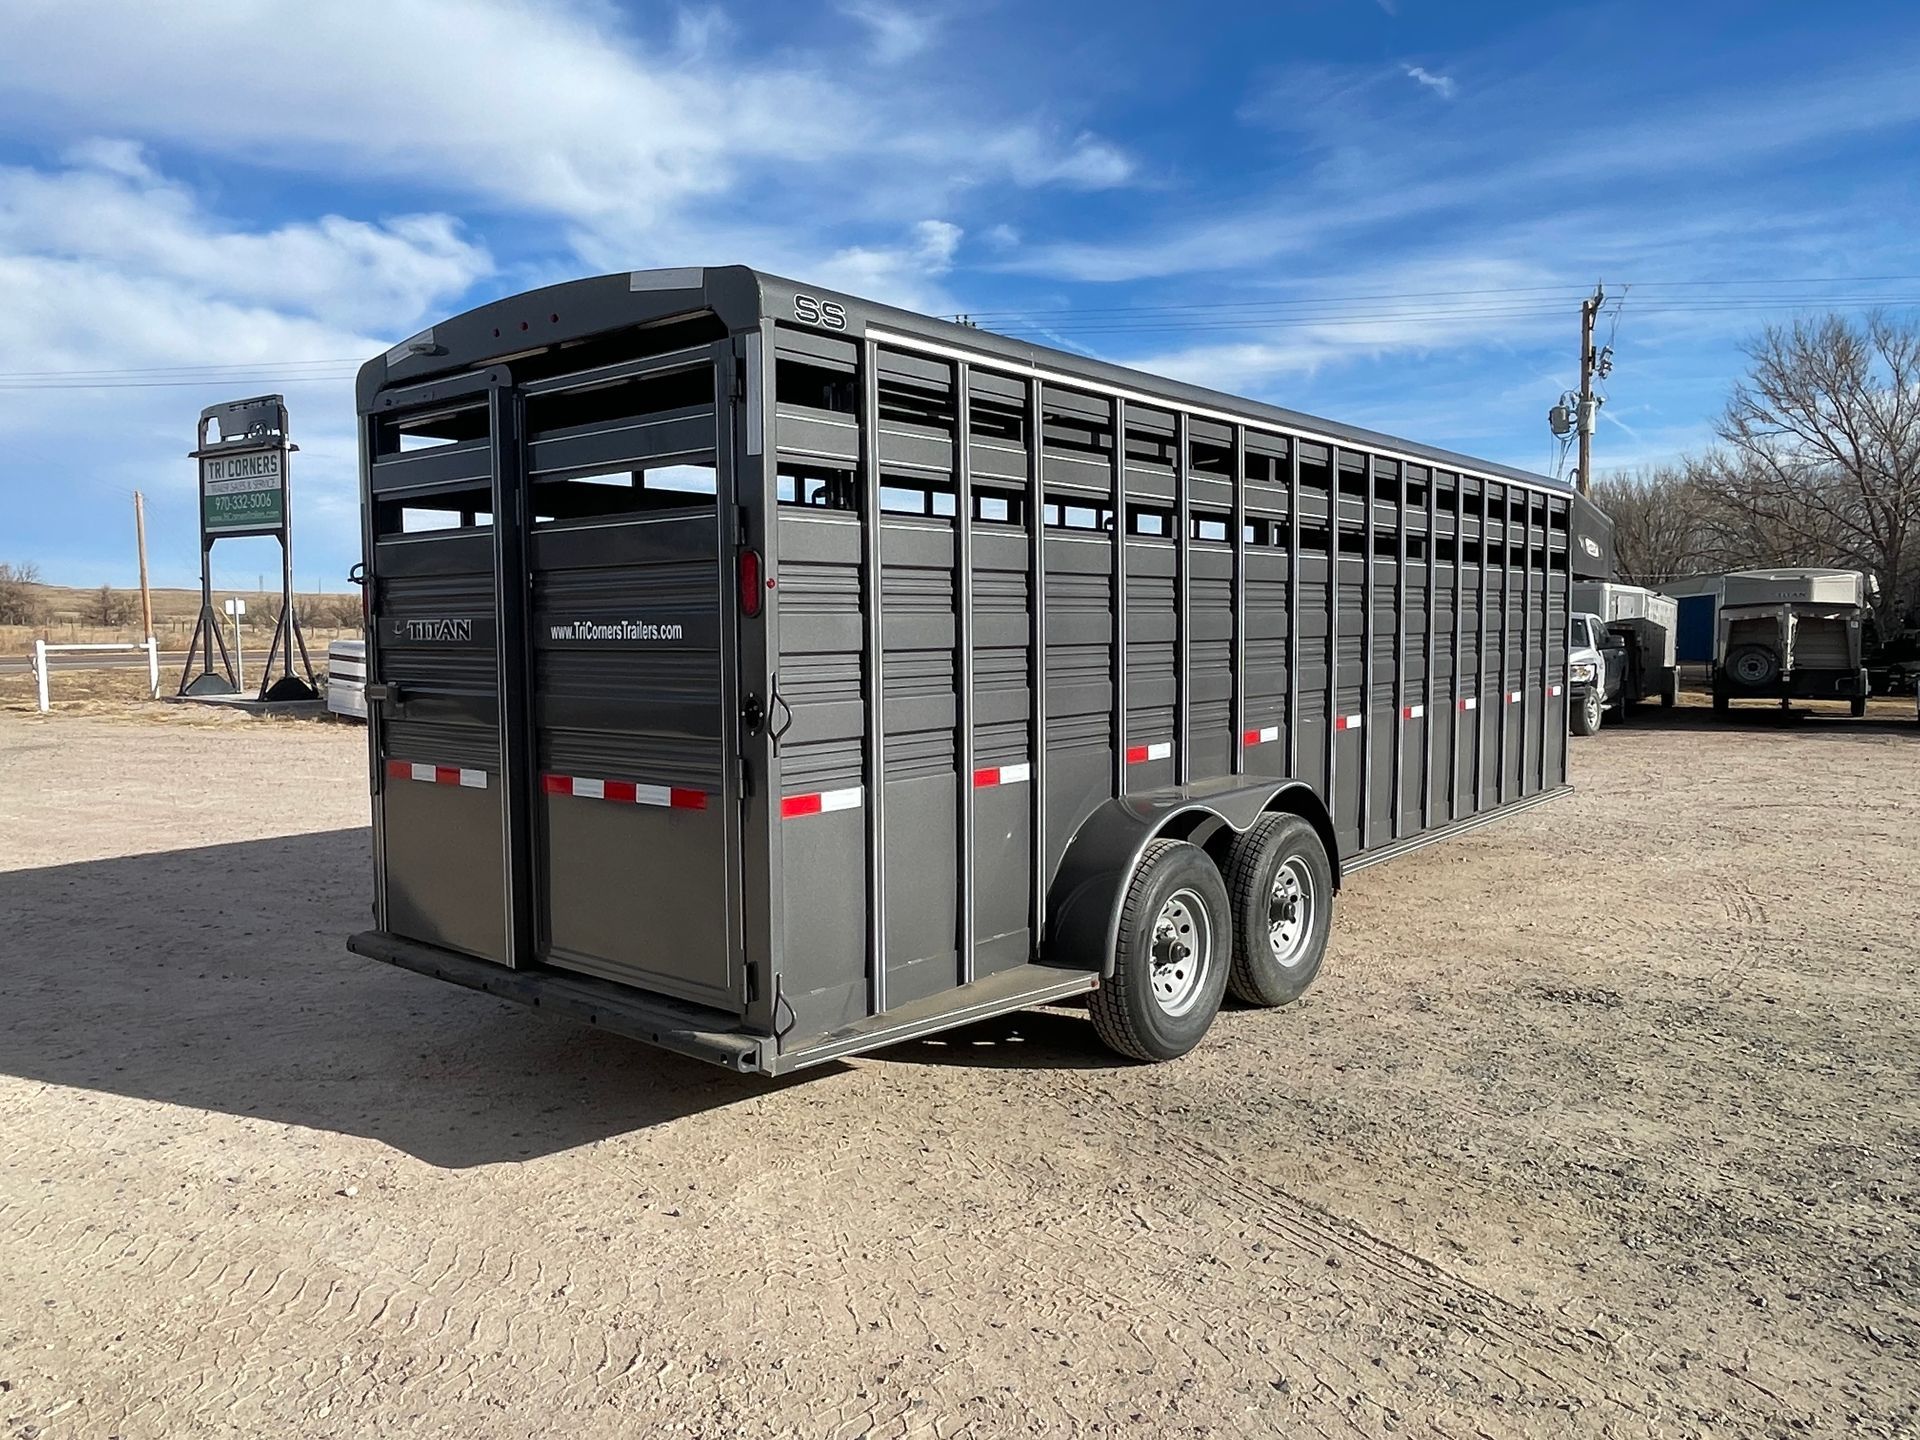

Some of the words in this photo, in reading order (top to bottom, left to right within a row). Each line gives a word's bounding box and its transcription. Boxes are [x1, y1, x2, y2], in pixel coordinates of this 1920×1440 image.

[793, 293, 847, 332] SS
[208, 461, 225, 479] TRI
[228, 455, 277, 477] CORNERS
[215, 493, 272, 511] 970-332-5006
[406, 619, 472, 641] TITAN
[551, 620, 683, 640] www.TriCornersTrailers.com
